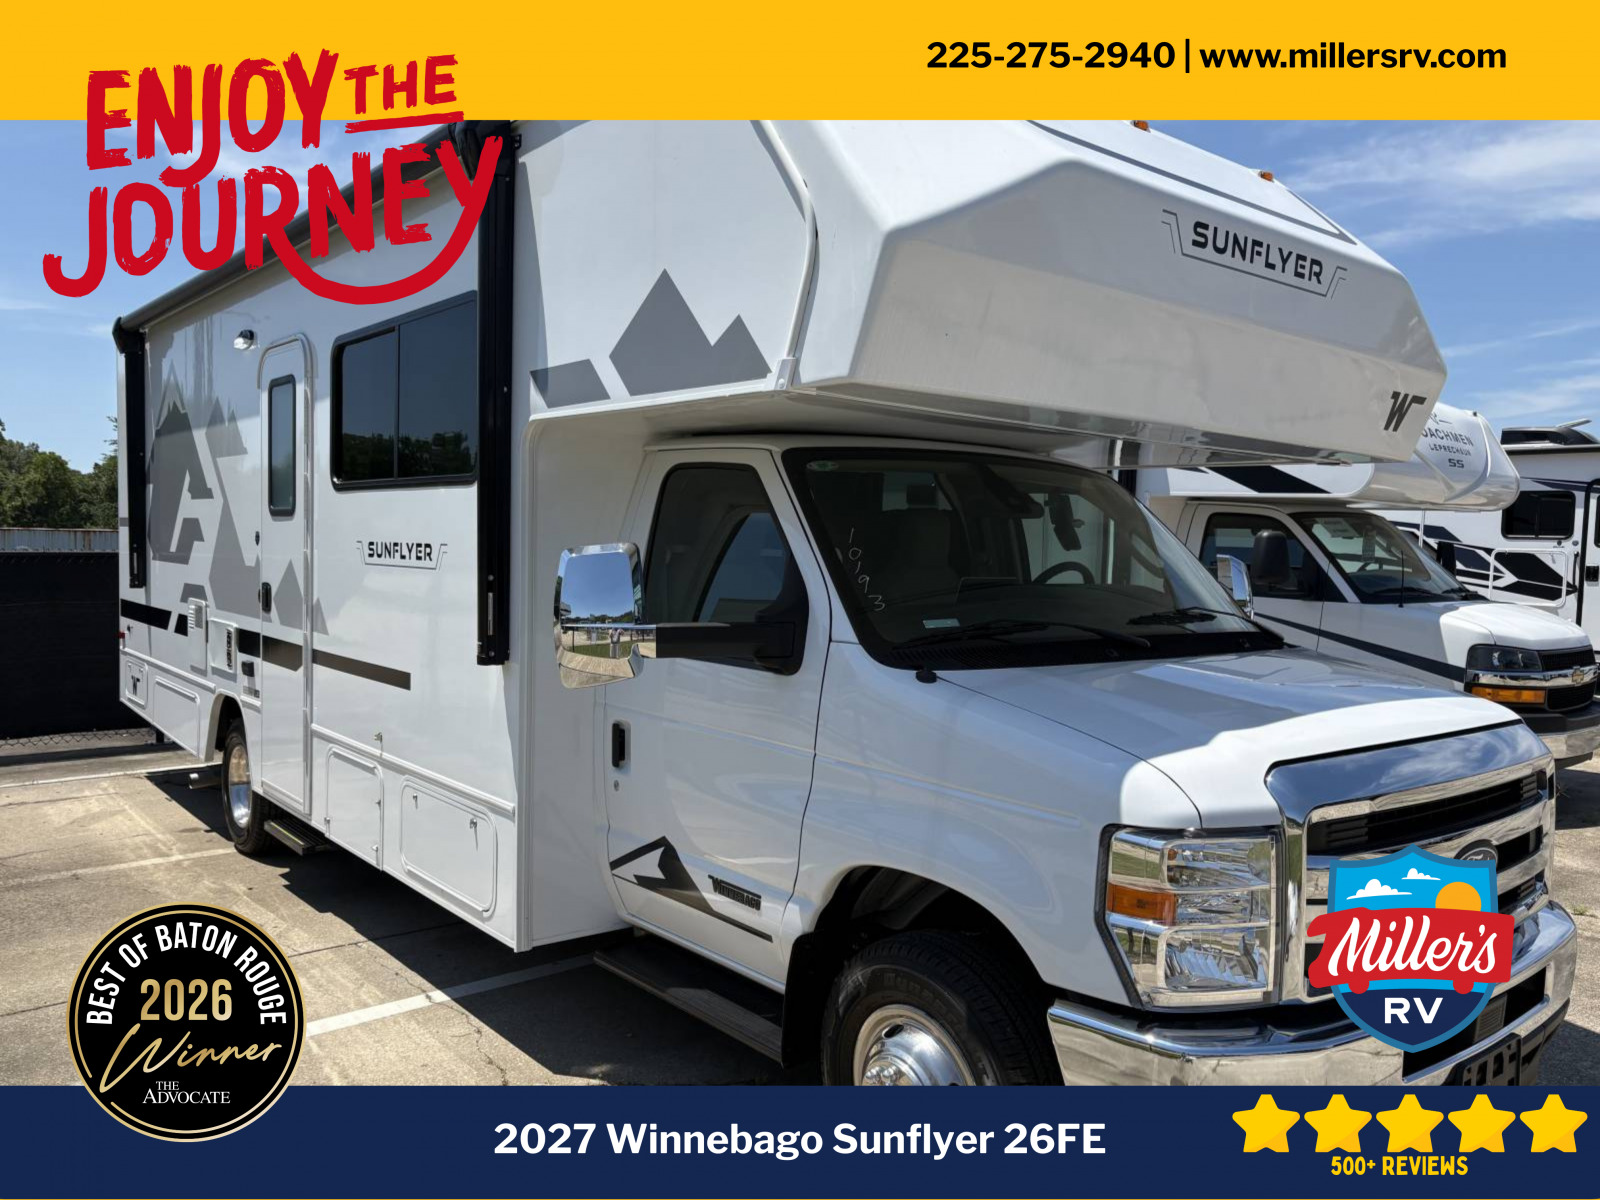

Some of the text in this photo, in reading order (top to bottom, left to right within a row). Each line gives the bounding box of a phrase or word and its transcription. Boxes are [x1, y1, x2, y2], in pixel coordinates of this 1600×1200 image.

[1191, 219, 1324, 286] SUNFLYER
[1421, 427, 1475, 447] OACHMEN
[1447, 458, 1465, 469] SS
[367, 541, 433, 562] SUNFLYER
